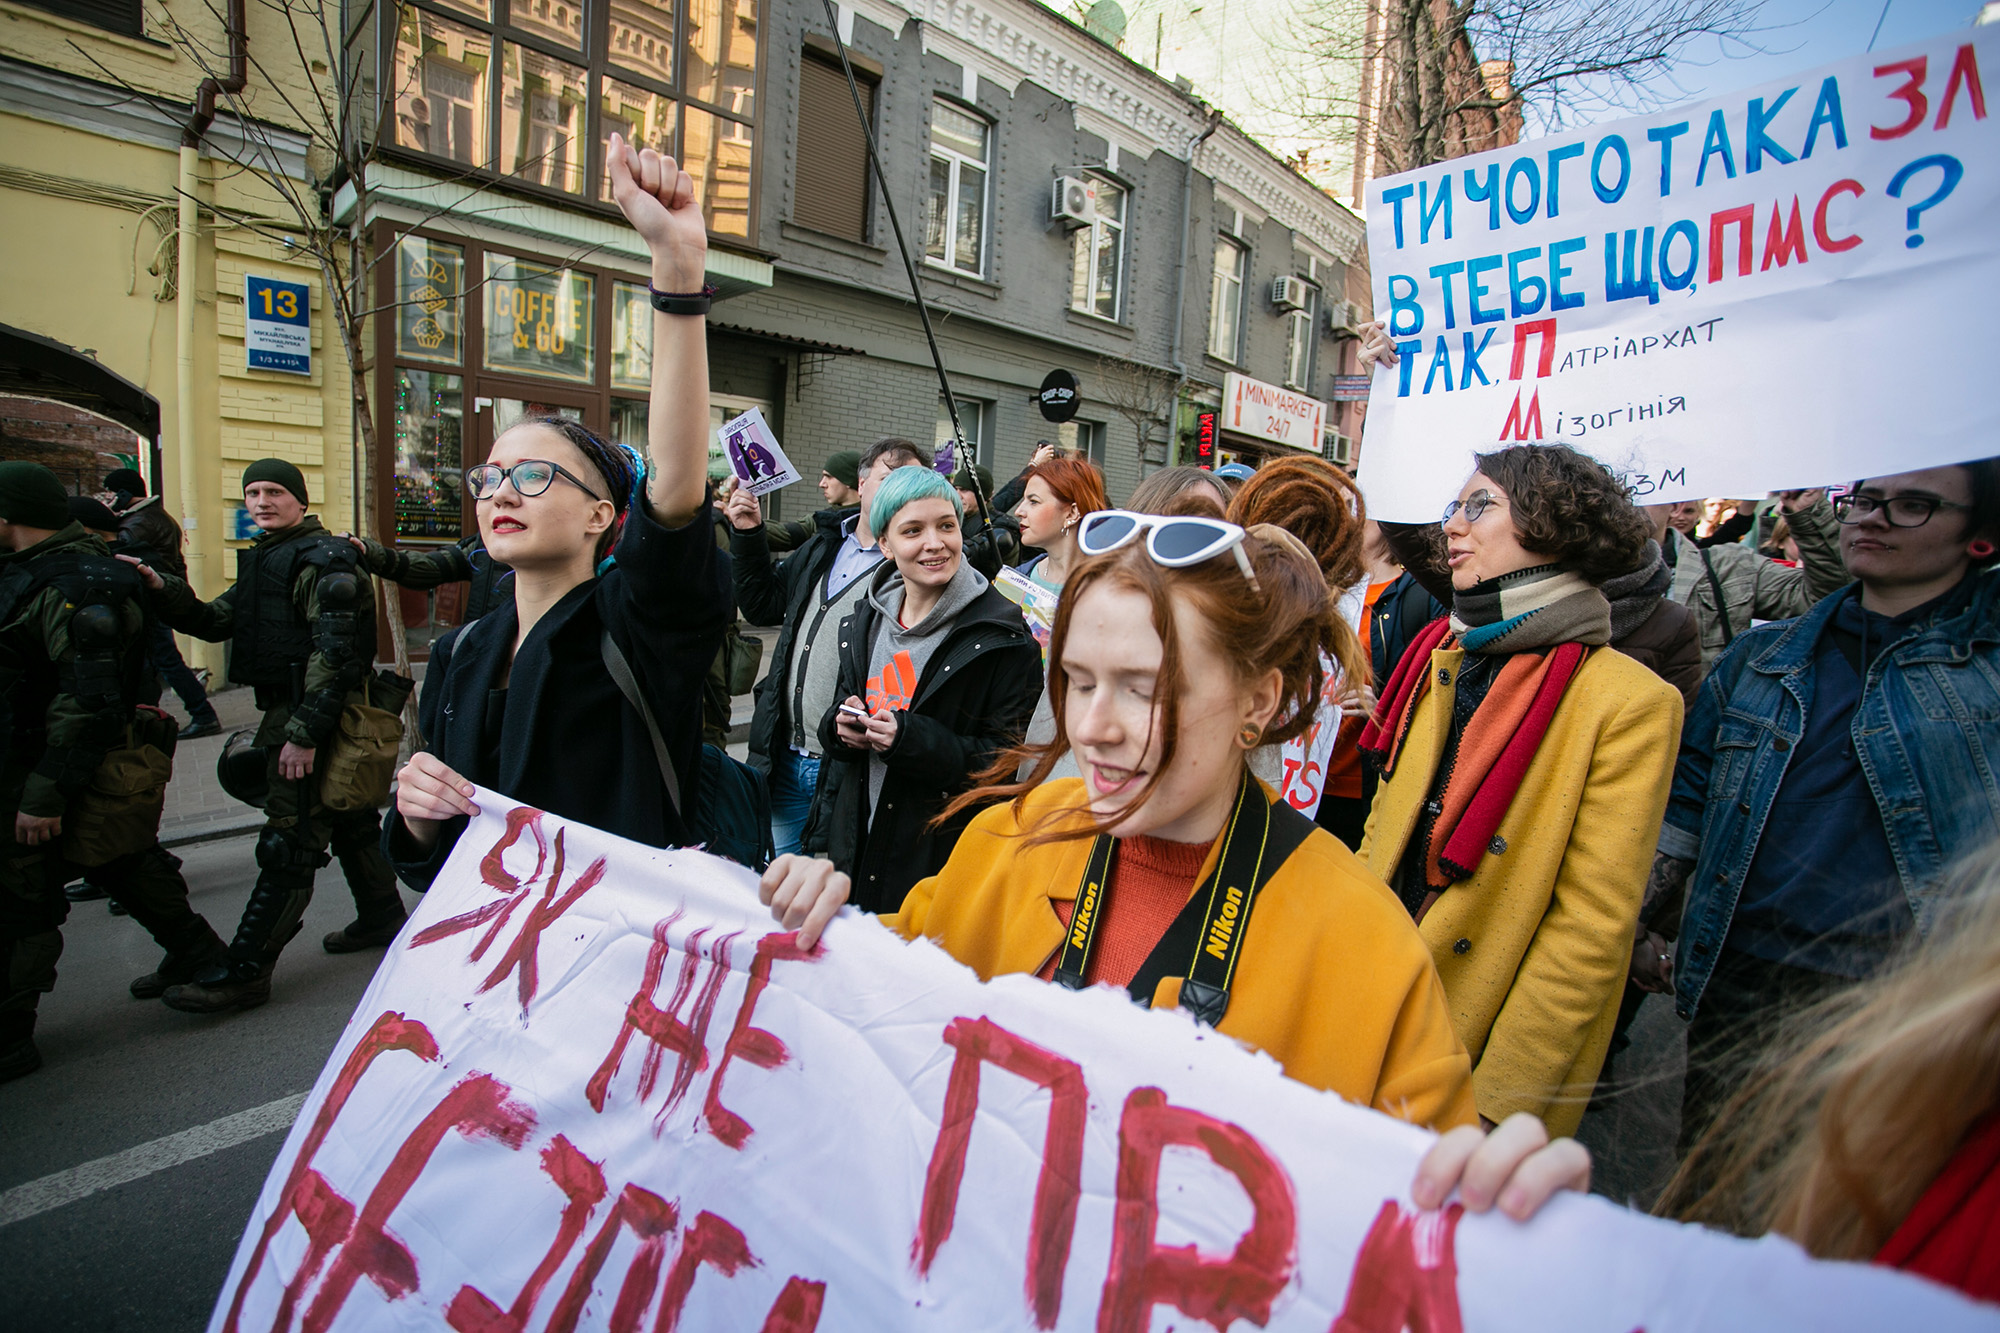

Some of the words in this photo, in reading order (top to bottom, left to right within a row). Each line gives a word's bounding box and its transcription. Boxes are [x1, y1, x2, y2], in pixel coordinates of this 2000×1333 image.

[1382, 174, 1453, 249] ТИ
[1464, 134, 1631, 231] ЧОГО
[1647, 76, 1848, 197] ТАКА
[1388, 275, 1425, 337] В
[1429, 236, 1586, 329] ТЕБЕ
[1605, 219, 1700, 305] ЩО,
[258, 288, 298, 318] 13
[495, 284, 582, 330] COFFEE
[253, 330, 305, 341] МИХАЙЛІВСЬКА
[512, 317, 530, 350] &
[536, 321, 565, 355] GO
[259, 355, 272, 363] 1/3
[1394, 327, 1501, 398] ТАК,
[1245, 382, 1314, 420] MINIMARKET
[1266, 416, 1291, 439] 24/7
[407, 806, 608, 1010] ЯК
[1071, 881, 1099, 950] Nikon
[1205, 886, 1244, 961] Nikon
